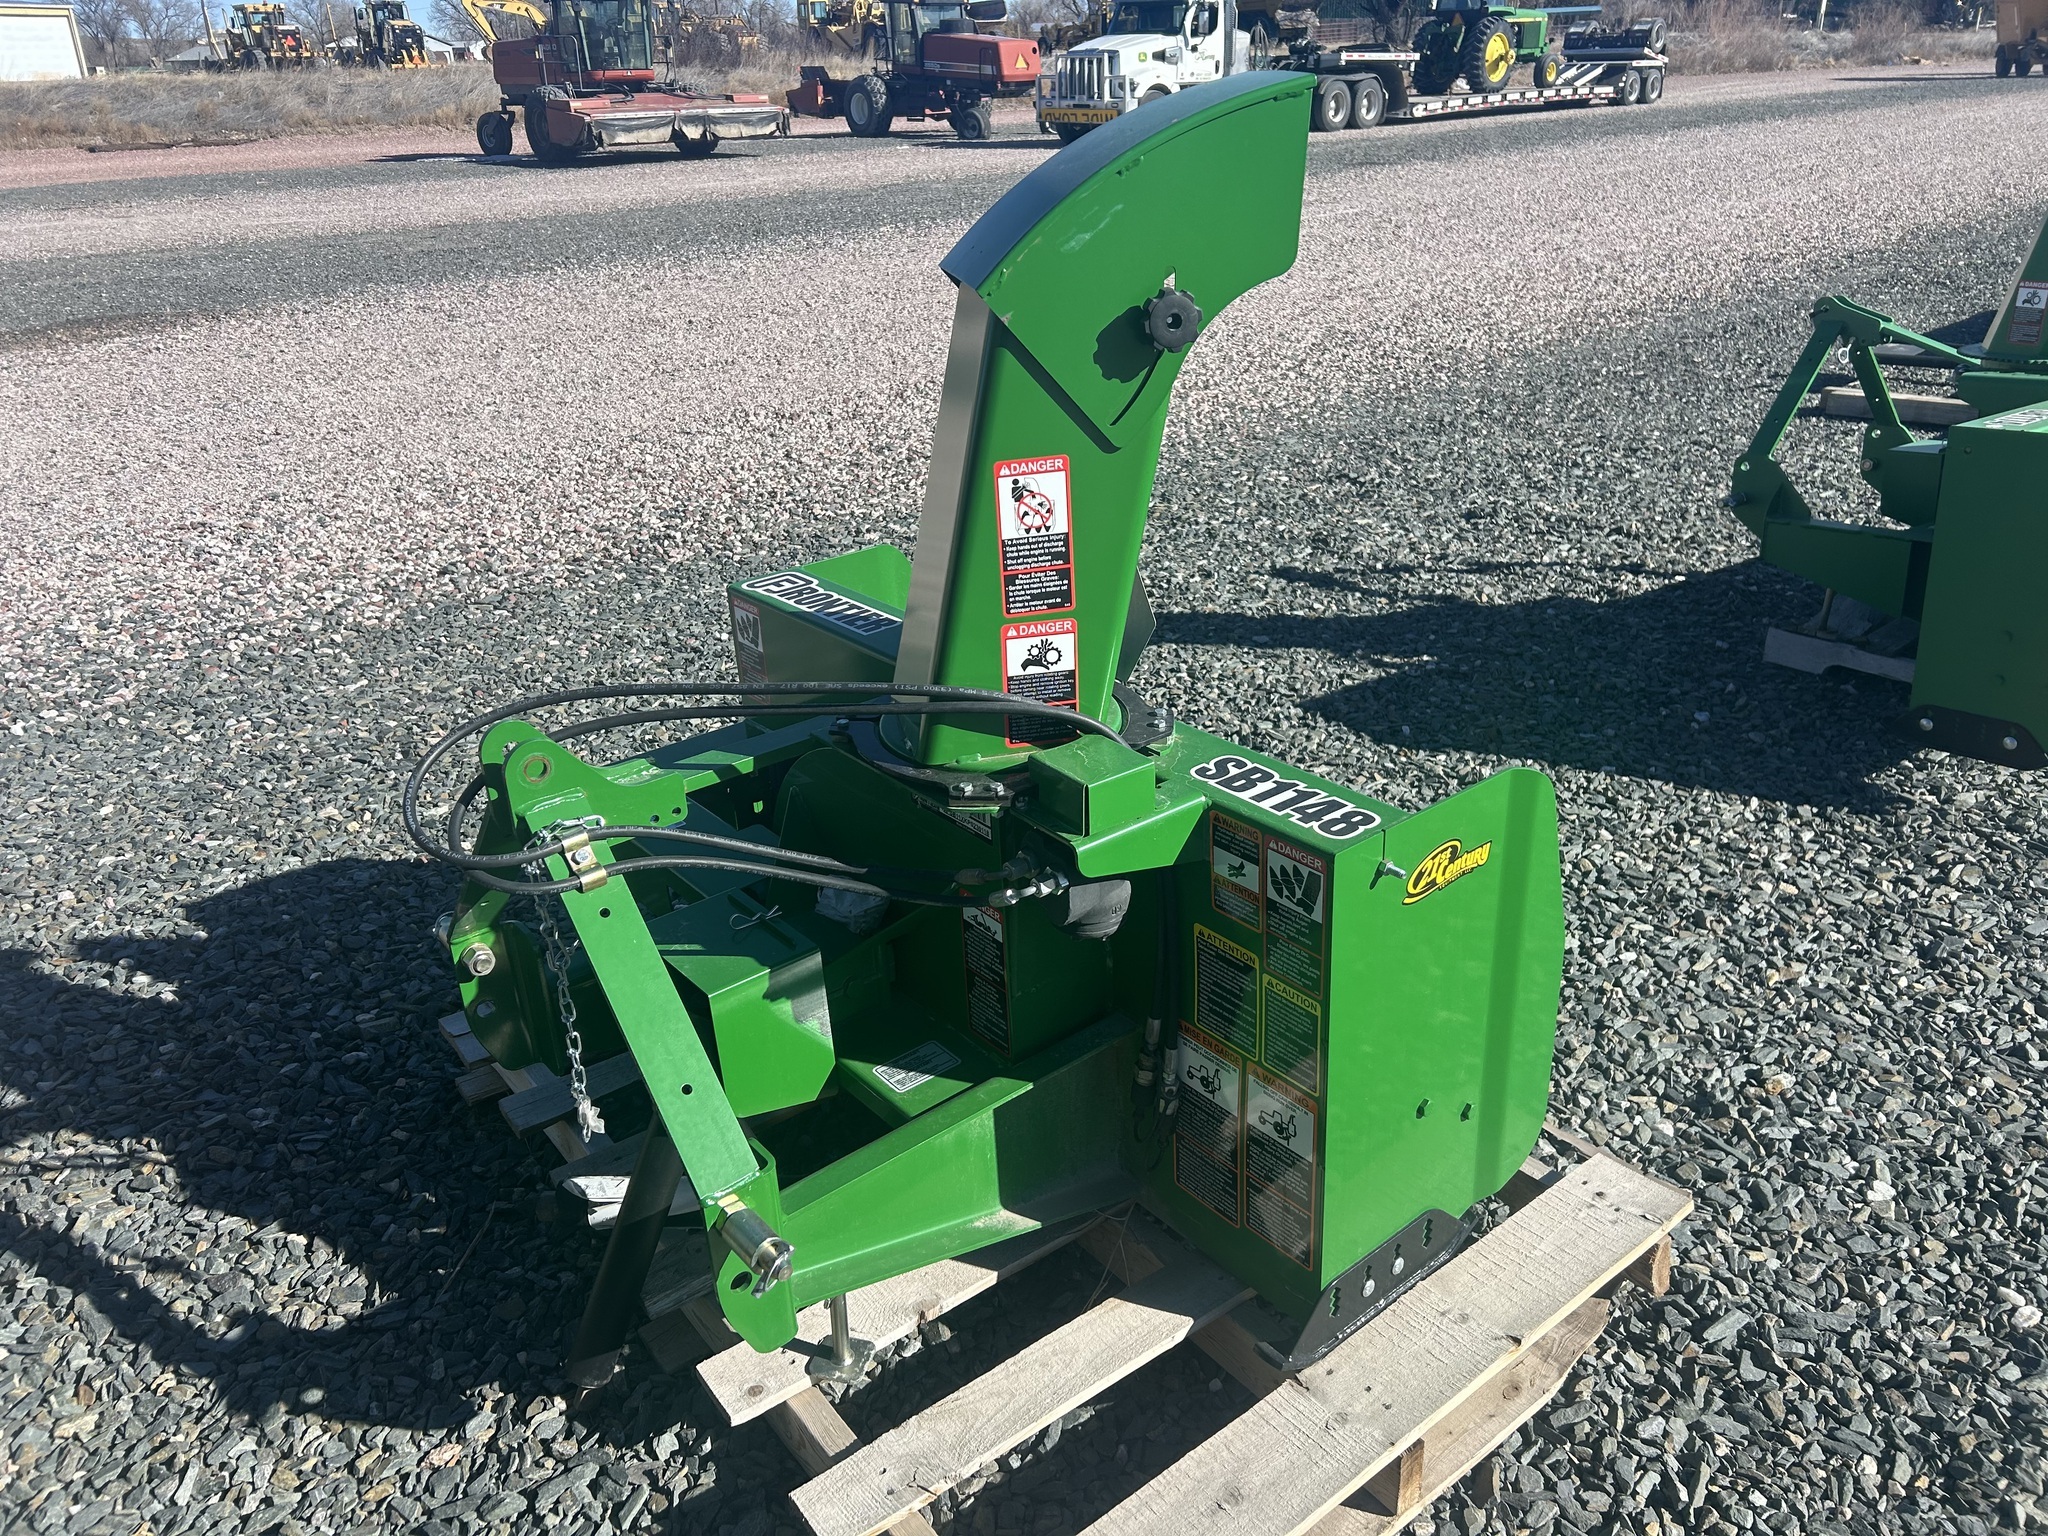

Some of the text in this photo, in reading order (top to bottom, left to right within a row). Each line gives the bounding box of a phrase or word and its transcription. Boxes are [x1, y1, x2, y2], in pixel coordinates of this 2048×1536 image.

[1011, 459, 1063, 474] DANGER
[746, 573, 902, 634] FRONTIER
[1020, 621, 1072, 635] DANGER
[1194, 757, 1378, 837] SB1148
[1221, 816, 1258, 840] WARNING
[1278, 842, 1322, 870] DANGER
[1222, 879, 1260, 905] ATTENTION
[1207, 933, 1256, 965] ATTENTION
[1275, 982, 1318, 1012] CAUTION
[1183, 1026, 1240, 1065] MISE EN GARDE
[1262, 1073, 1309, 1108] WARNING
